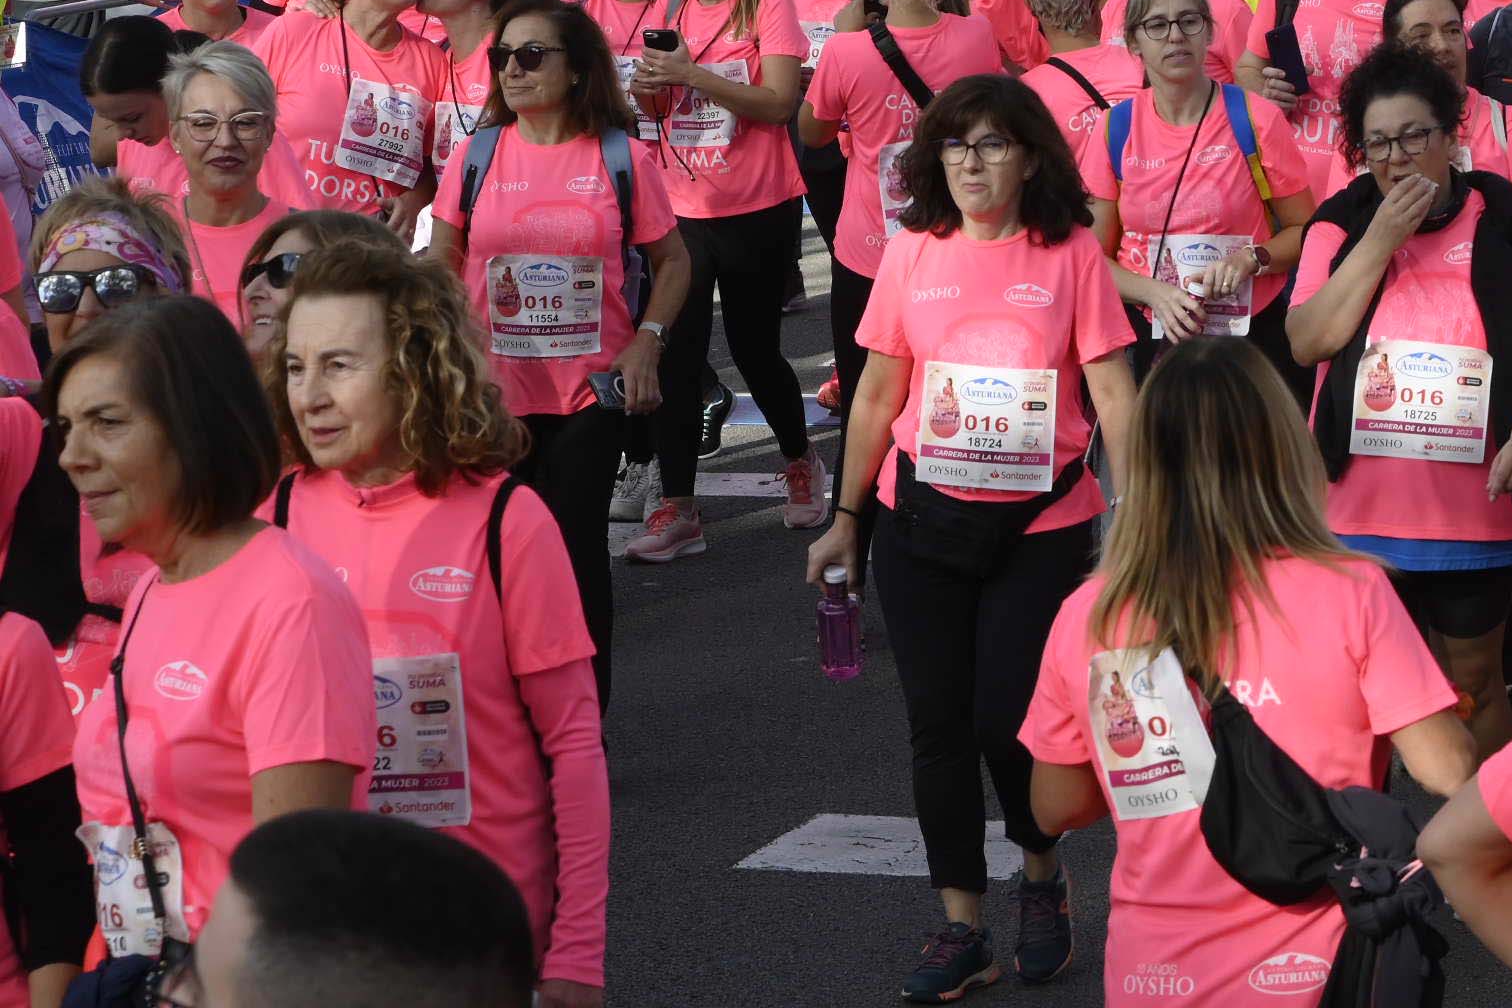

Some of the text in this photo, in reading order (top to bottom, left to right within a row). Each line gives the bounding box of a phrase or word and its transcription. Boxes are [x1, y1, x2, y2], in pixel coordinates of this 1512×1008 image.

[696, 111, 720, 120] 22397
[379, 121, 410, 141] 016
[56, 142, 90, 157] ECHERA
[308, 139, 336, 165] TU
[378, 138, 404, 153] 27992
[344, 154, 373, 168] OYSHO
[1180, 251, 1220, 262] ASTURIANA
[521, 271, 567, 282] ASTURIANA
[911, 286, 960, 303] OYSHO
[1008, 289, 1051, 303] ASTURIANA
[524, 295, 563, 309] 016
[528, 313, 559, 323] 11554
[500, 326, 530, 334] CARRERA
[531, 326, 541, 334] DE
[541, 326, 550, 334] LA
[551, 325, 574, 333] MUJER
[559, 339, 592, 348] Santander
[1400, 361, 1449, 375] ASTURIANA
[1457, 361, 1483, 370] SUMA
[963, 386, 1014, 401] ASTURIANA
[1400, 387, 1444, 406] 016
[1403, 409, 1438, 421] 18725
[964, 414, 1009, 433] 016
[1368, 422, 1473, 436] CARRERA DE LA MUJER 2023
[967, 436, 1003, 449] 18724
[1363, 437, 1403, 449] OYSHO
[1434, 442, 1474, 454] Santander
[933, 449, 1040, 463] CARRERA DE LA MUJER 2023
[928, 463, 968, 478] OYSHO
[1001, 470, 1042, 481] Santander
[408, 678, 447, 690] SUMA
[372, 756, 392, 770] 22
[1123, 765, 1170, 783] CARRERA
[380, 776, 449, 788] MUJER 2023
[1127, 787, 1178, 808] OYSHO
[394, 800, 456, 814] Santander
[101, 903, 124, 929] 16
[1123, 975, 1196, 996] OYSHO
[1255, 971, 1327, 986] ASTURIANA
